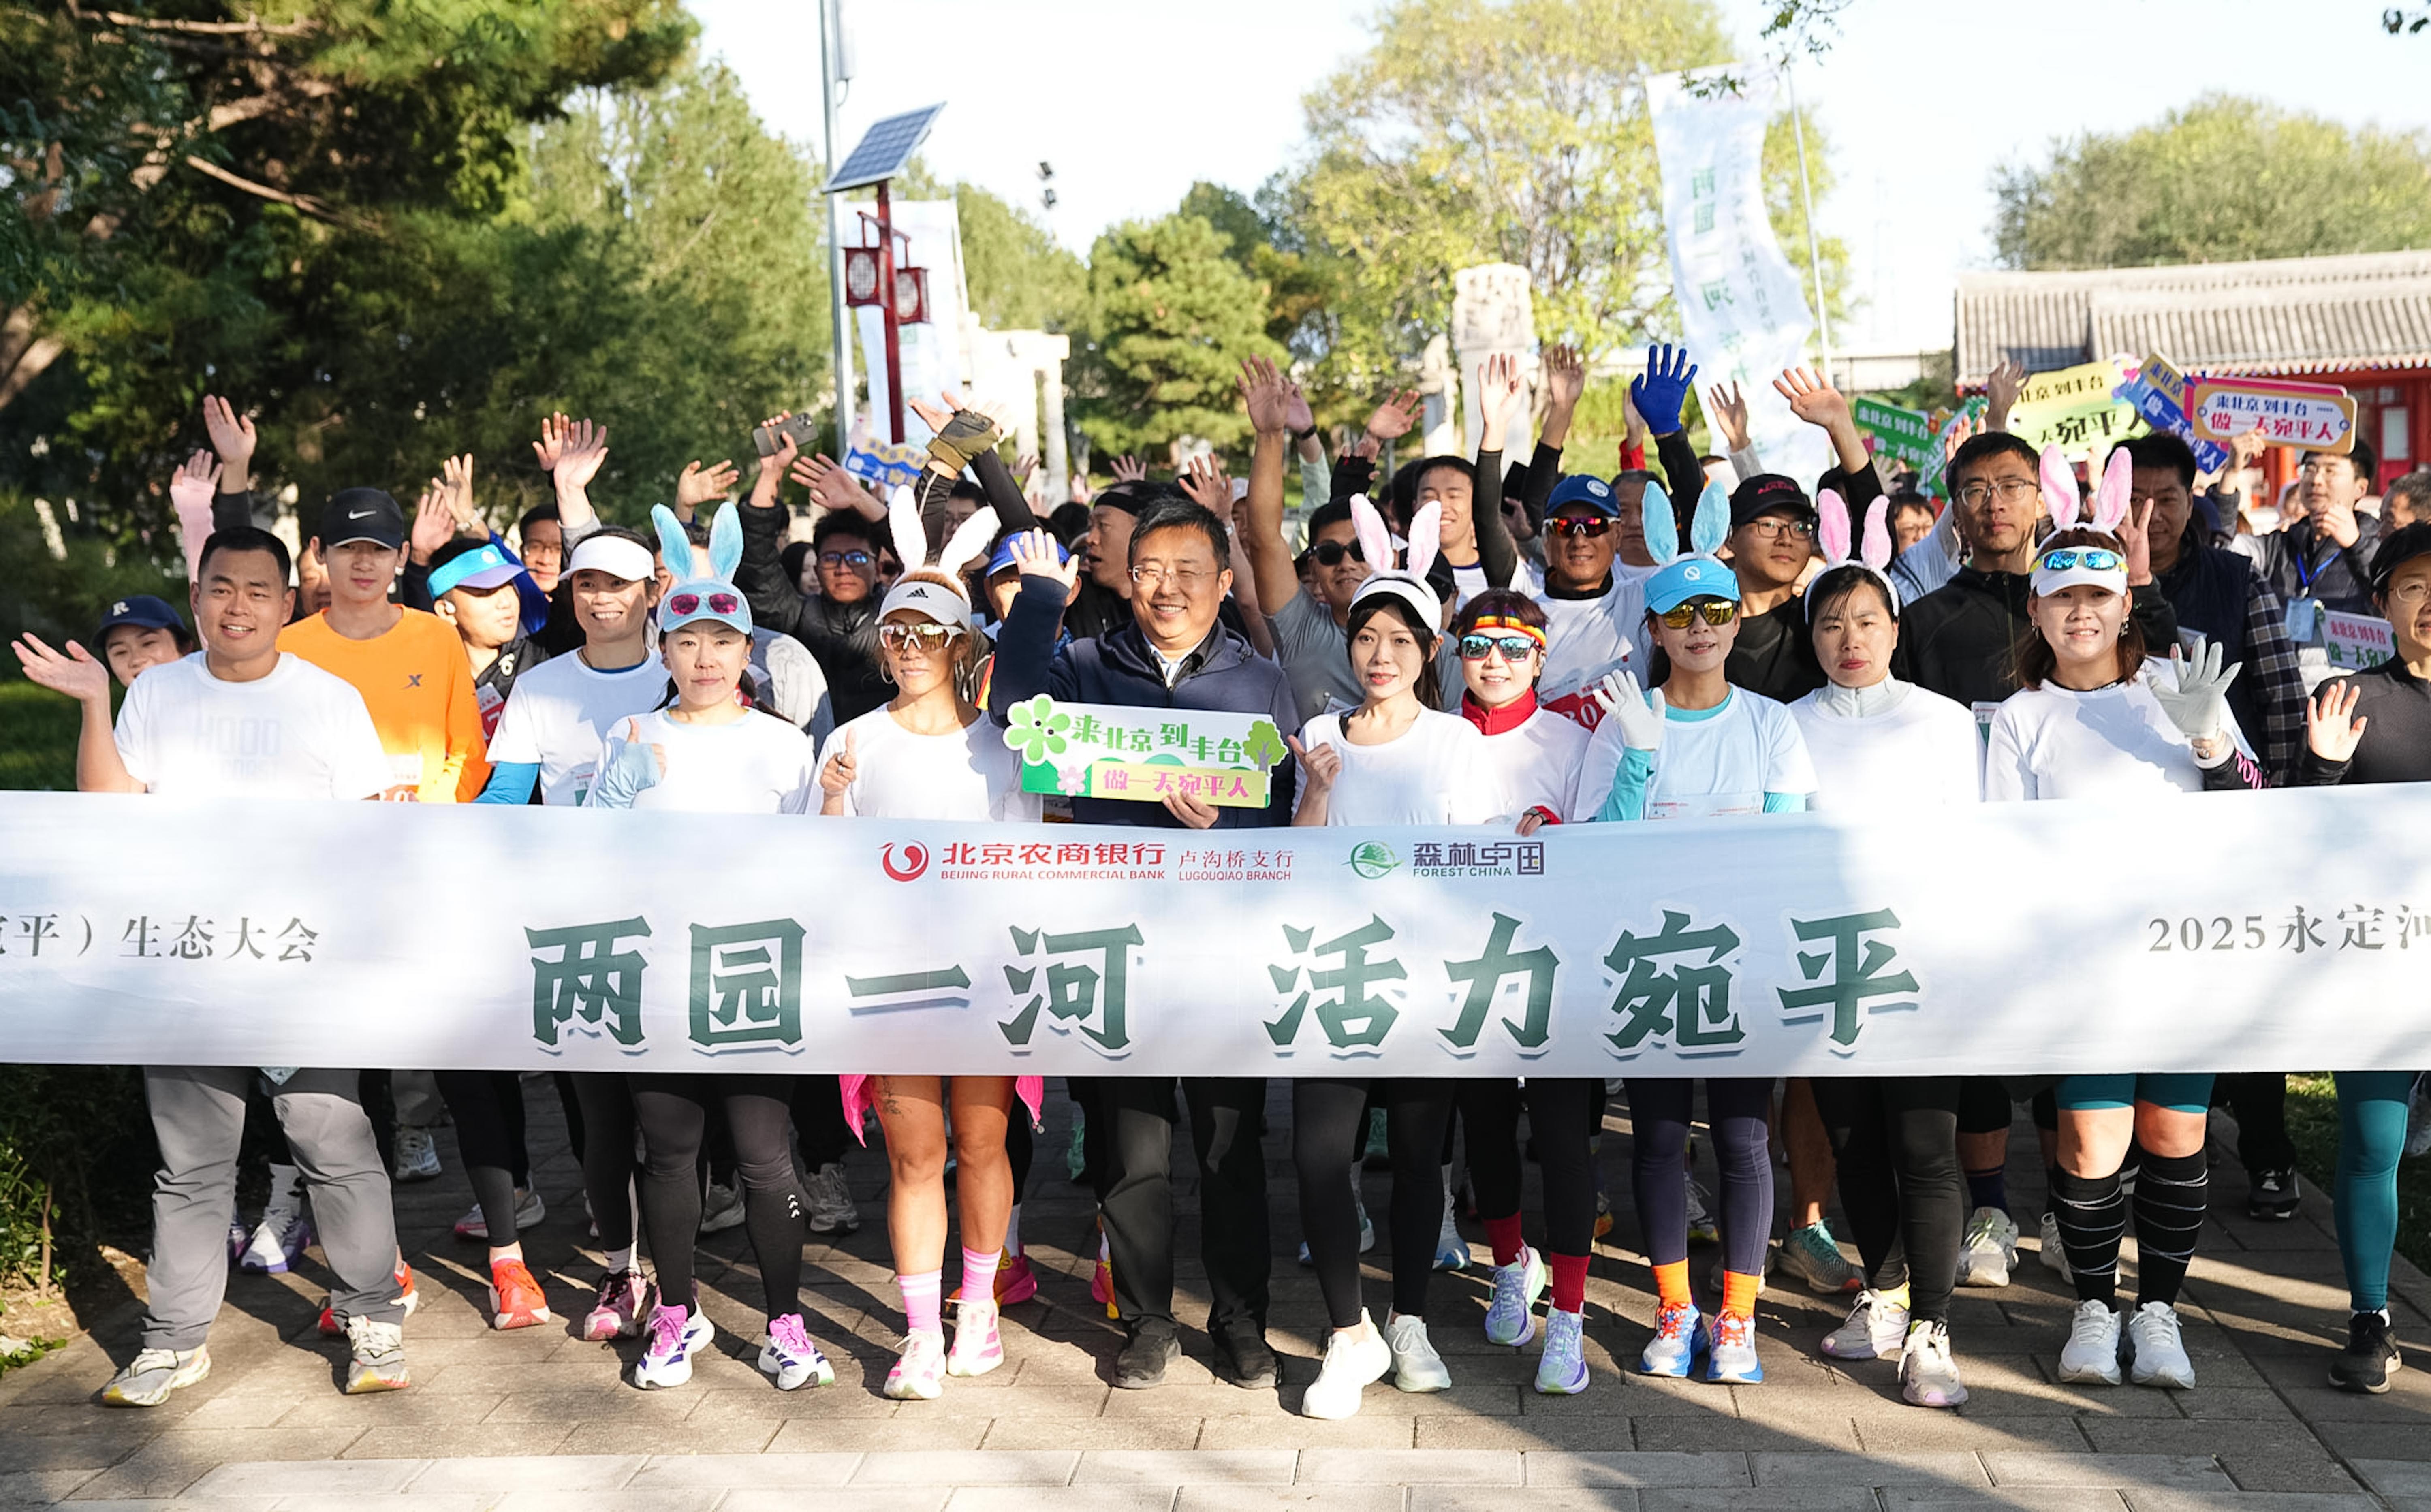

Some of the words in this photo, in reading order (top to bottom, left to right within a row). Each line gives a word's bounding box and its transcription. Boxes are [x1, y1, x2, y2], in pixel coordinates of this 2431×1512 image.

[2217, 395, 2308, 416] 来北京到丰台
[2211, 412, 2334, 441] 做一天宛平人
[113, 601, 130, 617] R
[1071, 714, 1242, 763] 来北京到丰台
[1103, 769, 1249, 798] 做一天宛平人
[942, 842, 1166, 865] 北京农商银行
[1179, 850, 1295, 869] 卢沟桥支行
[1413, 841, 1544, 875] 森林中国
[941, 870, 989, 880] BEIJING
[992, 870, 1034, 880] RURAL
[1038, 870, 1127, 880] COMMERCIAL
[1129, 869, 1166, 880] BANK
[1178, 871, 1244, 882] LUGOUQIAO
[1246, 871, 1292, 881] BRANCH
[1413, 867, 1464, 877] FOREST
[1469, 867, 1512, 877] CHINA
[0, 913, 320, 962] 平）生态大会
[524, 916, 1145, 1053] 两园一河
[1263, 912, 1920, 1050] 活力宛平
